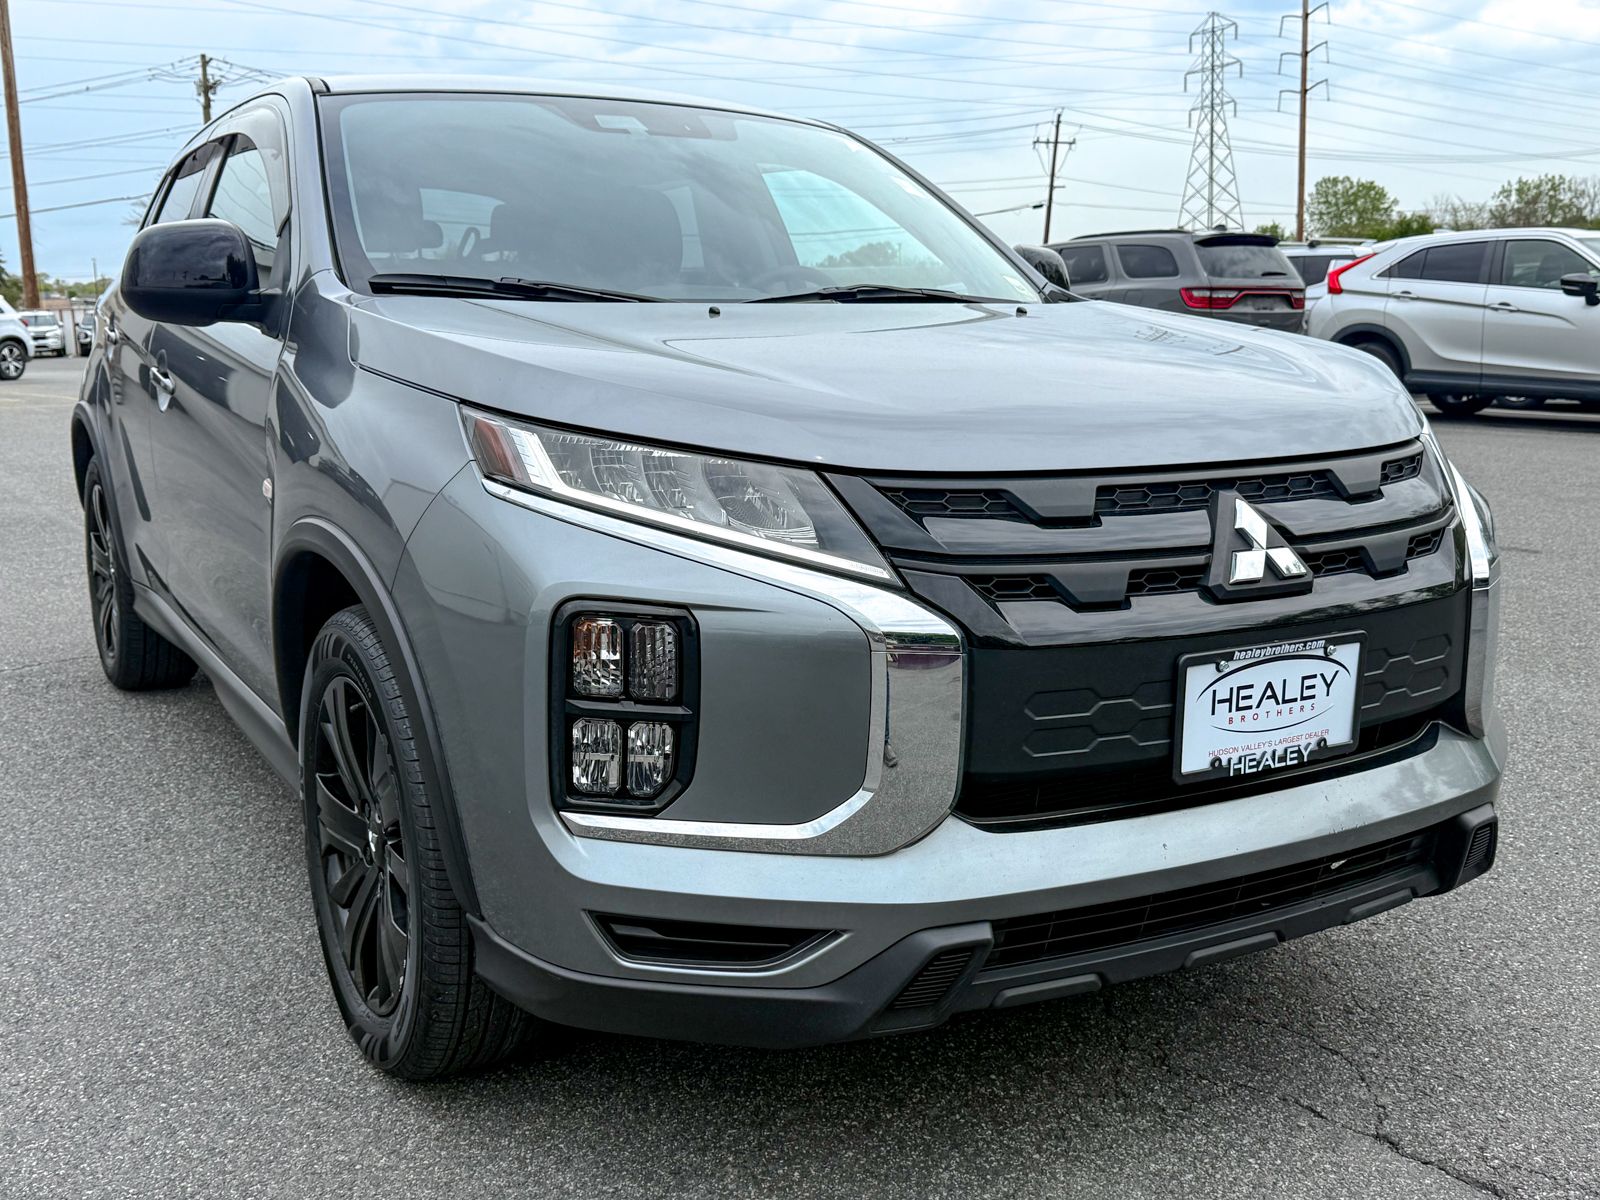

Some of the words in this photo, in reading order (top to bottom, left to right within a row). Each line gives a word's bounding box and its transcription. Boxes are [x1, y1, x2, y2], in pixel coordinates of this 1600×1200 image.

[1233, 639, 1326, 660] healeybrothers.com
[1211, 670, 1339, 715] HEALEY
[1228, 703, 1316, 725] BROTHERS
[1208, 745, 1239, 757] HUDSON
[1240, 740, 1273, 752] VALLEY'S
[1274, 734, 1304, 746] LARGEST
[1304, 729, 1330, 740] DEALER
[1230, 744, 1313, 776] HEALEY
